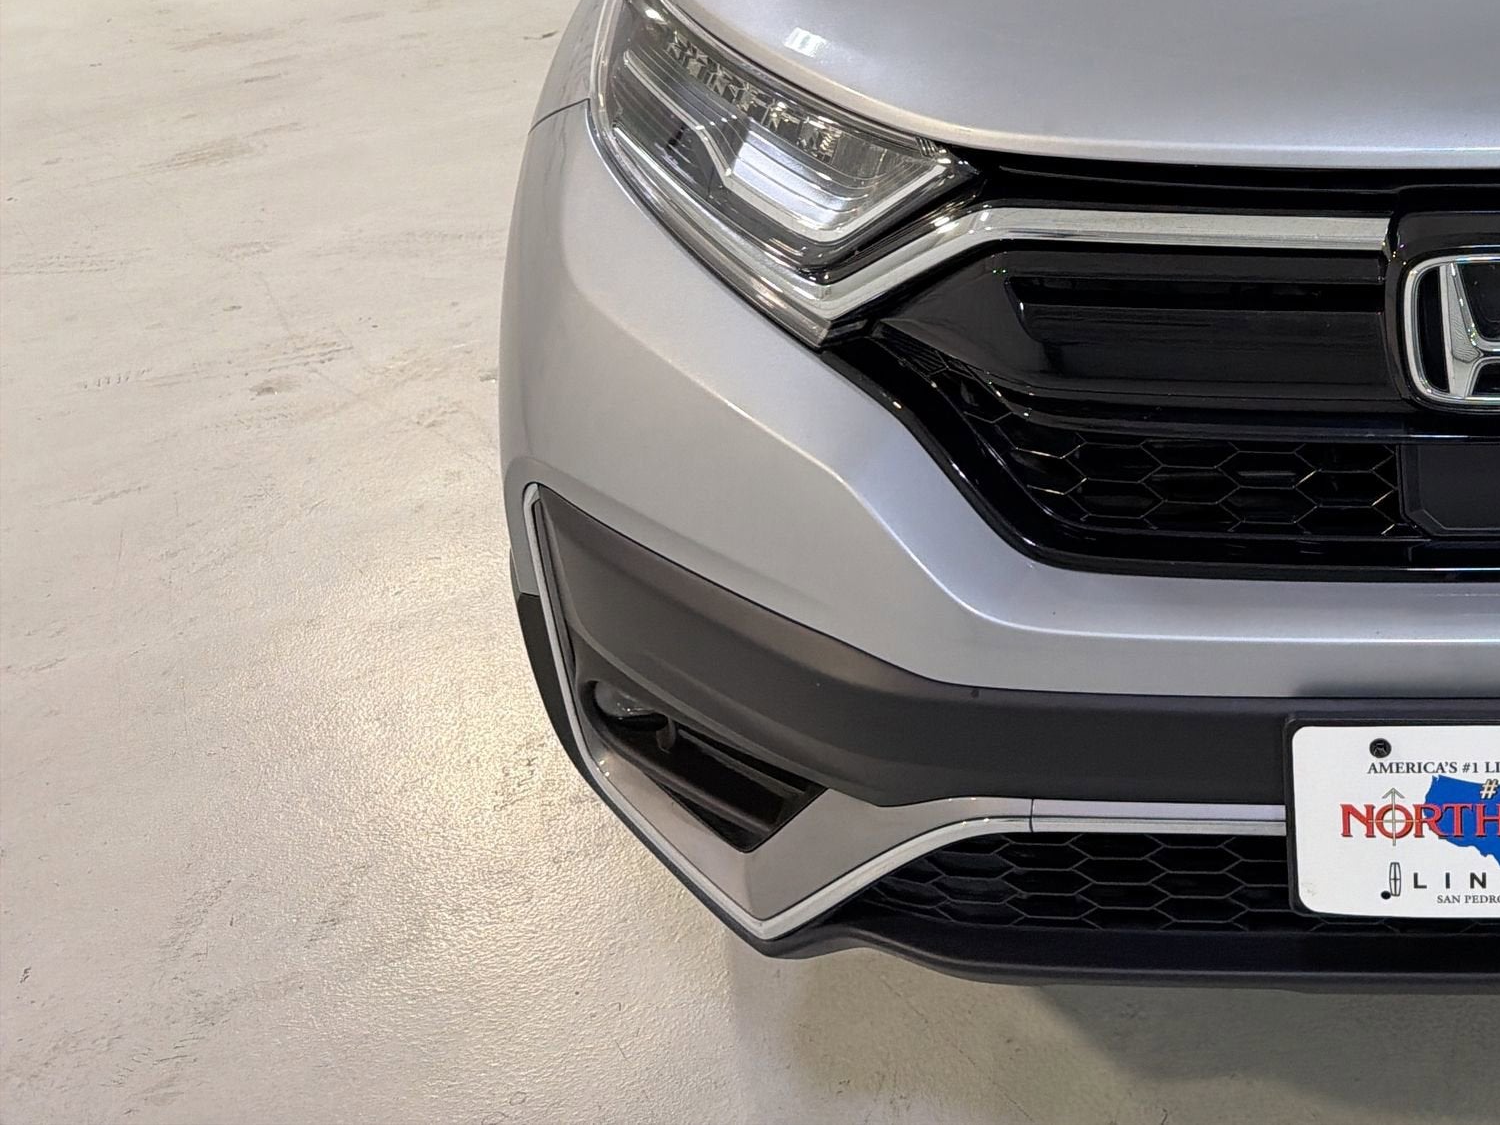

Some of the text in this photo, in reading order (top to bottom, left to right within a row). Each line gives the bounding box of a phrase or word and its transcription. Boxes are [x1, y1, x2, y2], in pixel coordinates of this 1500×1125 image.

[1367, 761, 1458, 774] AMERICA'S
[1462, 761, 1479, 774] #1
[1437, 895, 1461, 904] SAN
